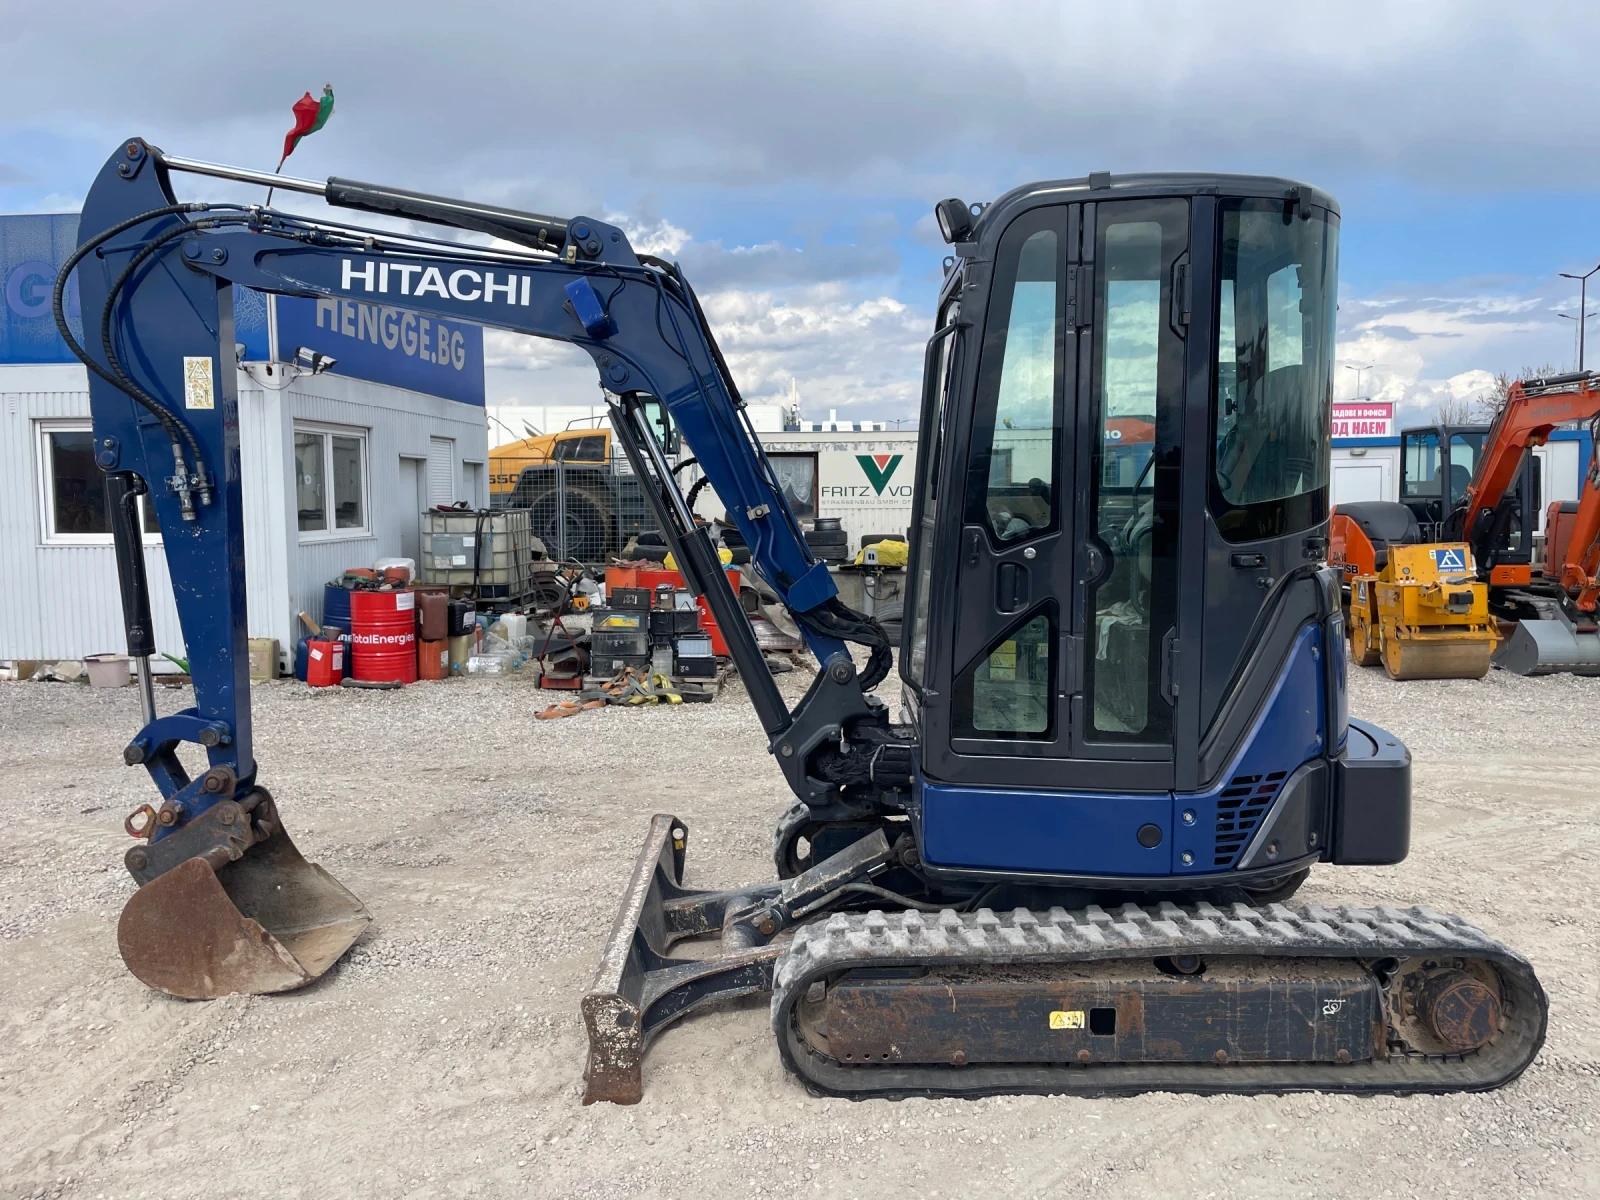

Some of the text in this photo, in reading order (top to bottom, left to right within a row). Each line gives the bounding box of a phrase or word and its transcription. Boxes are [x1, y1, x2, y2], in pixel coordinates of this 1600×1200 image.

[341, 259, 531, 307] HITACHI
[316, 299, 465, 371] HENGGE.BG
[1352, 422, 1386, 434] НАЕМ
[821, 486, 870, 497] FRITZ
[352, 632, 415, 645] TotalEnergies
